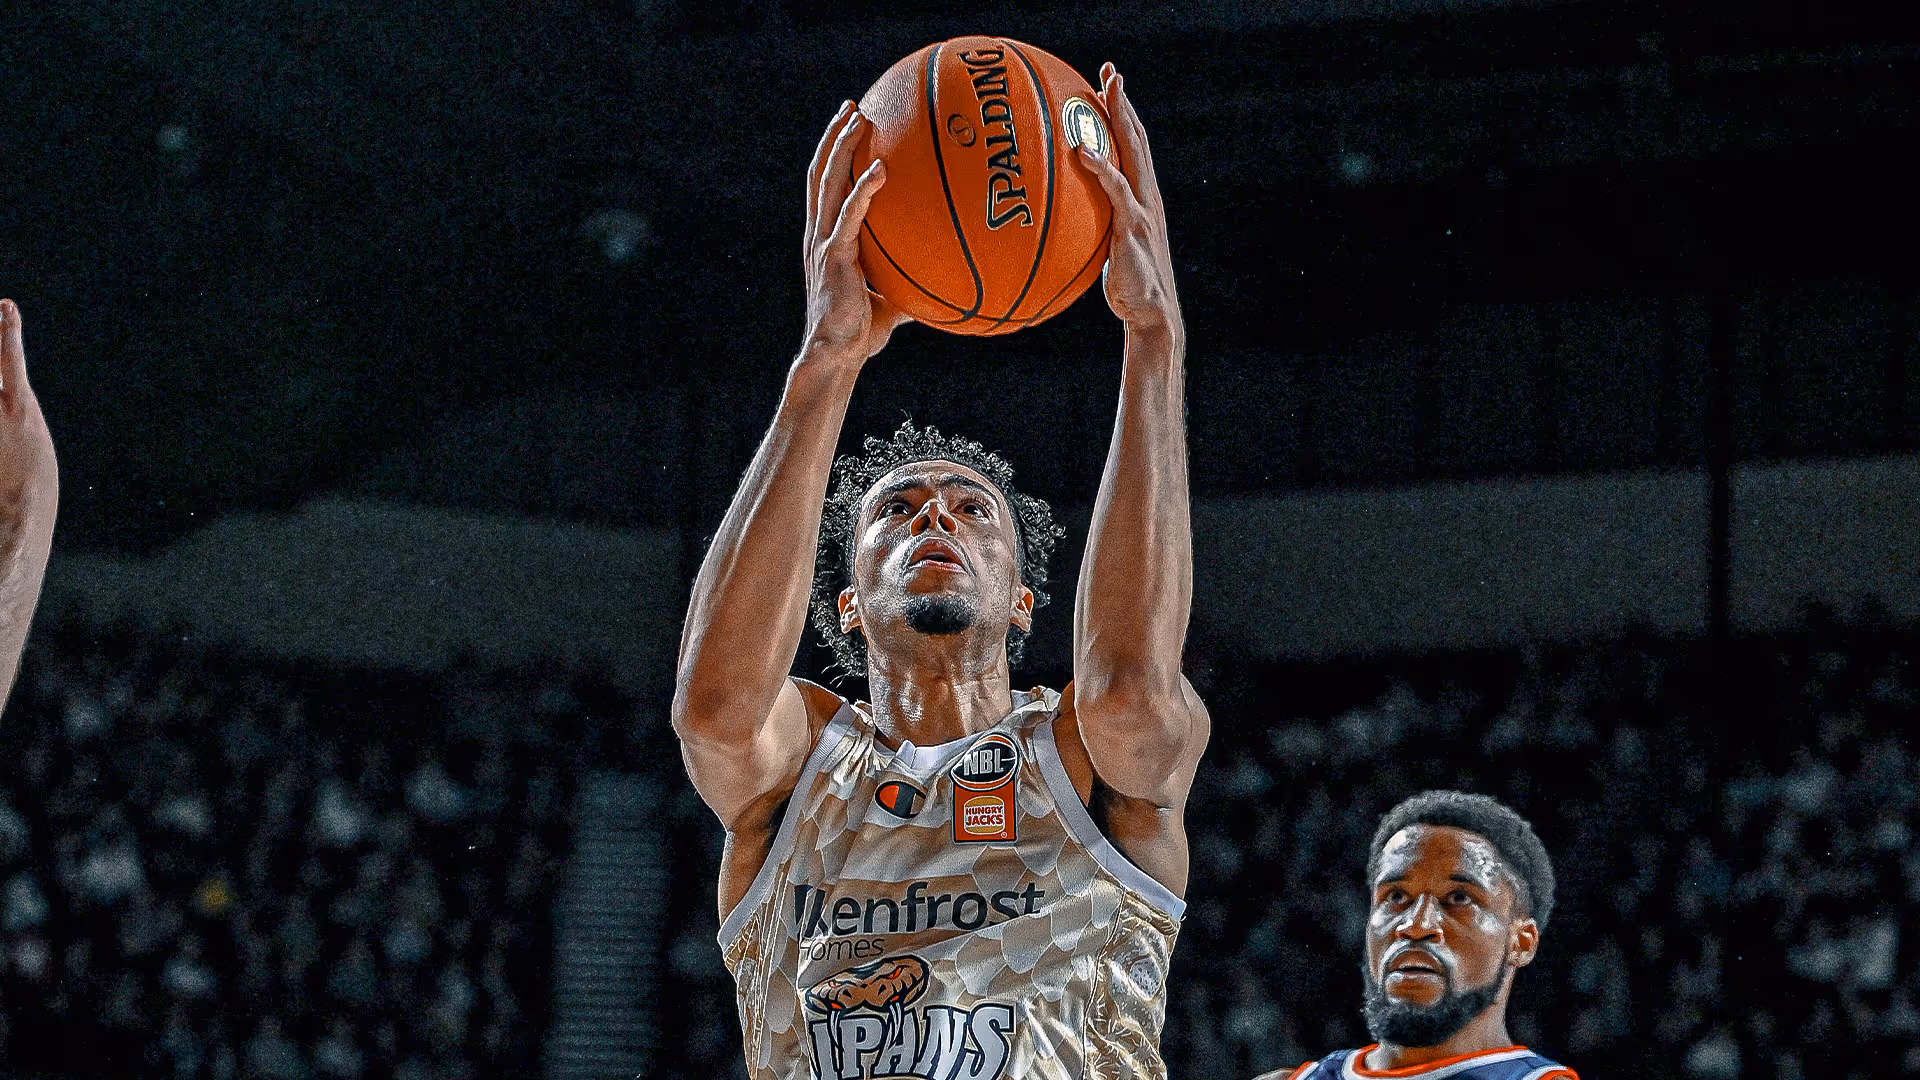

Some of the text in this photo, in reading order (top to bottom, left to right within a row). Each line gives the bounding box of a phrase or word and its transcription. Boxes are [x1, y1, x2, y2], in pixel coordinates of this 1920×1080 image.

[957, 46, 1034, 231] SPALDING
[963, 747, 1005, 776] NBL
[965, 806, 1003, 816] HUNGRY
